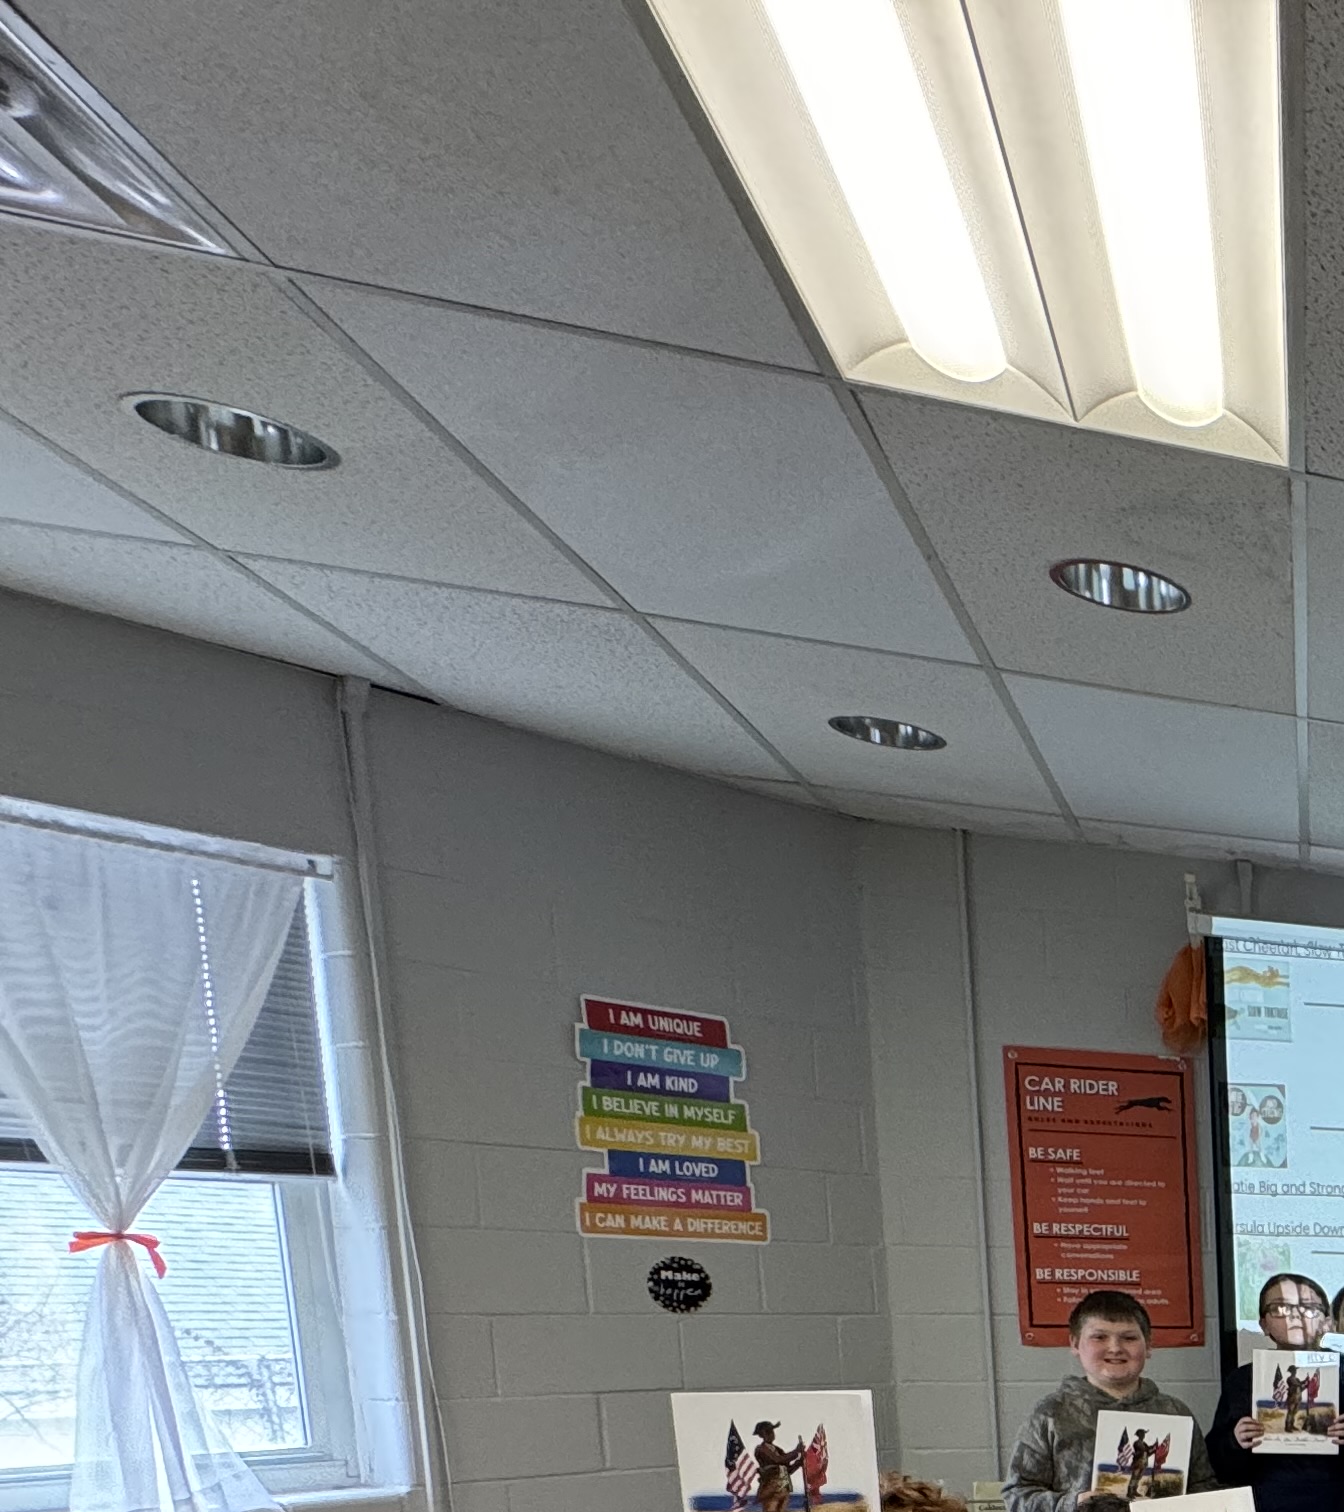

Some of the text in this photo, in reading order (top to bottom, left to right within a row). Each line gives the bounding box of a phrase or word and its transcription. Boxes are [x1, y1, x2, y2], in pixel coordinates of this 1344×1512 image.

[608, 1008, 703, 1037] I AM UNIQUE
[602, 1038, 720, 1068] I DON'T GIVE UP
[626, 1070, 698, 1093] I AM KIND
[1024, 1075, 1119, 1096] CAR RIDER
[591, 1095, 738, 1124] I BELIEVE IN MYSELF
[1026, 1096, 1064, 1112] LINE
[585, 1124, 750, 1154] I ALWAYS TRY MY BEST
[1028, 1147, 1081, 1161] BE SAFE
[638, 1157, 719, 1178] I AM LOVED
[593, 1182, 743, 1206] MY FEELINGS MATTER
[1232, 1181, 1256, 1192] atie
[1259, 1181, 1278, 1197] Big
[1282, 1181, 1306, 1194] and
[584, 1212, 763, 1236] I CAN MAKE A DIFFERENCE
[1033, 1222, 1130, 1237] BE RESPECTFUL
[1235, 1221, 1265, 1235] rsula
[1268, 1222, 1310, 1237] Upside
[660, 1269, 700, 1281] Make
[1035, 1268, 1140, 1282] BE RESPONSIBLE
